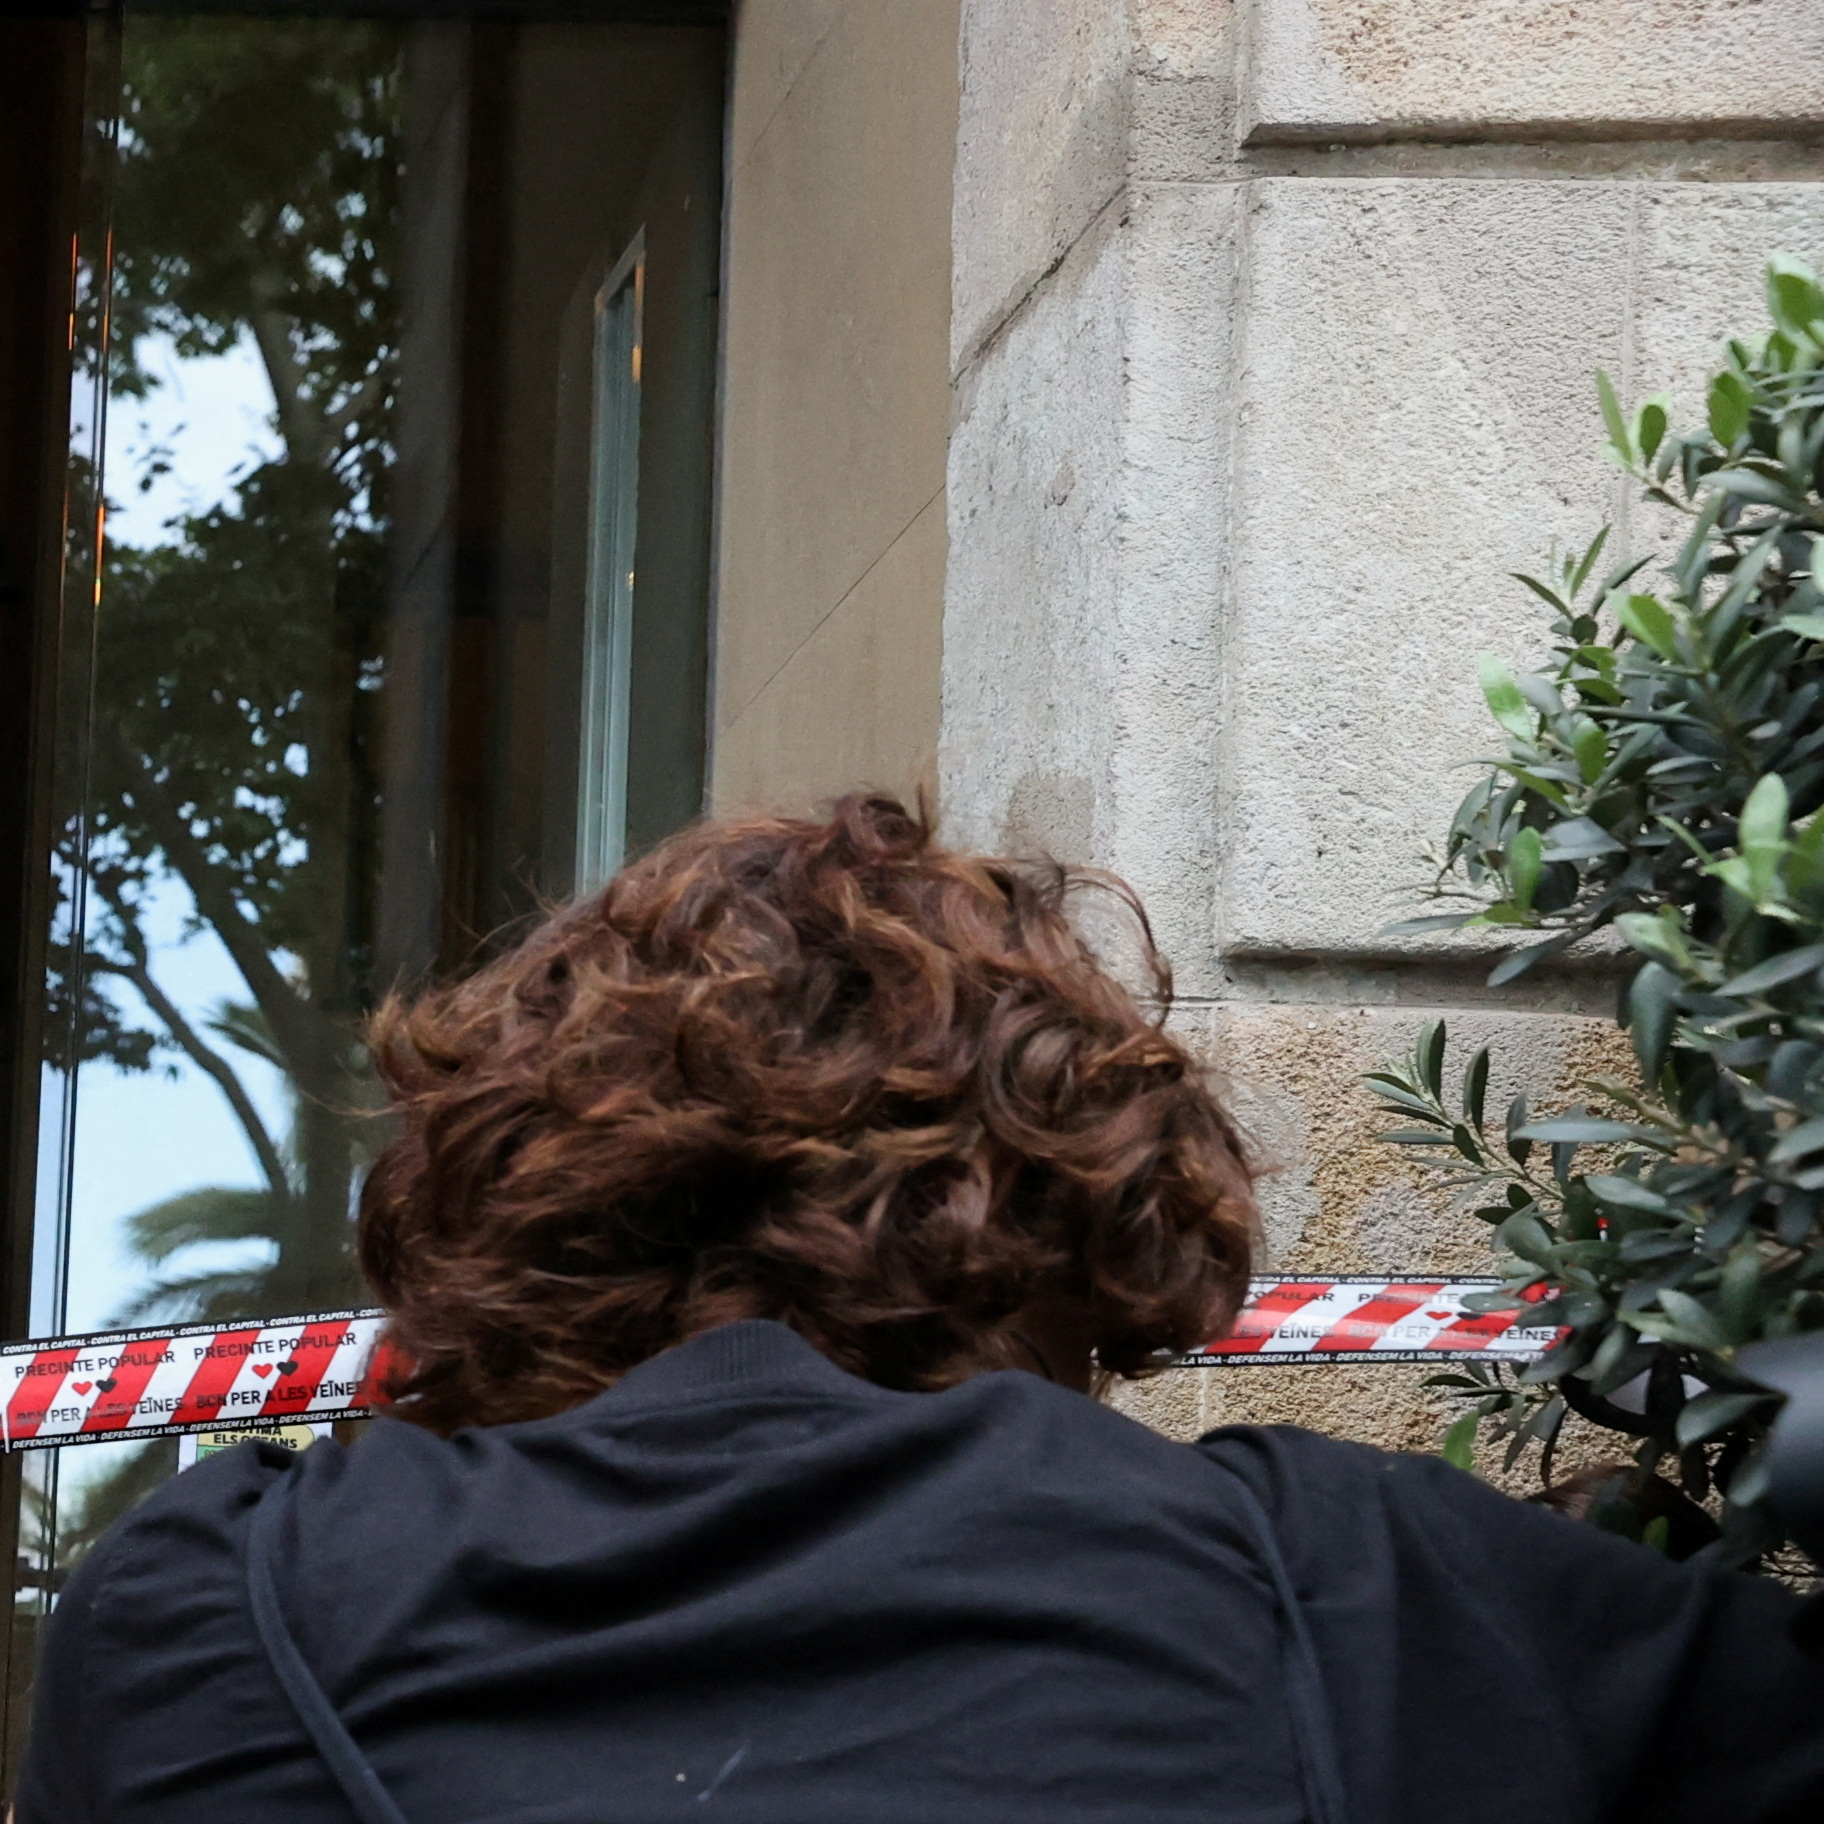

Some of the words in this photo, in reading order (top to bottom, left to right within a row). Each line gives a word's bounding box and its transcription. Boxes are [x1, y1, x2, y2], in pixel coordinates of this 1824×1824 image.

[269, 1315, 305, 1327] CONTRA
[318, 1311, 355, 1323] CAPITAL
[90, 1334, 125, 1345] CONTRA
[138, 1329, 175, 1341] CAPITAL
[193, 1339, 274, 1360] PRECINTE
[278, 1331, 356, 1352] POPULAR
[15, 1357, 93, 1378] PRECINTE
[97, 1349, 174, 1370] POPULAR
[229, 1388, 259, 1406] PER
[262, 1388, 272, 1404] A
[277, 1384, 305, 1403] LES
[50, 1406, 79, 1423] PER
[278, 1412, 328, 1425] DEFENSEM
[100, 1428, 149, 1441] DEFENSEM
[213, 1433, 239, 1445] ELS
